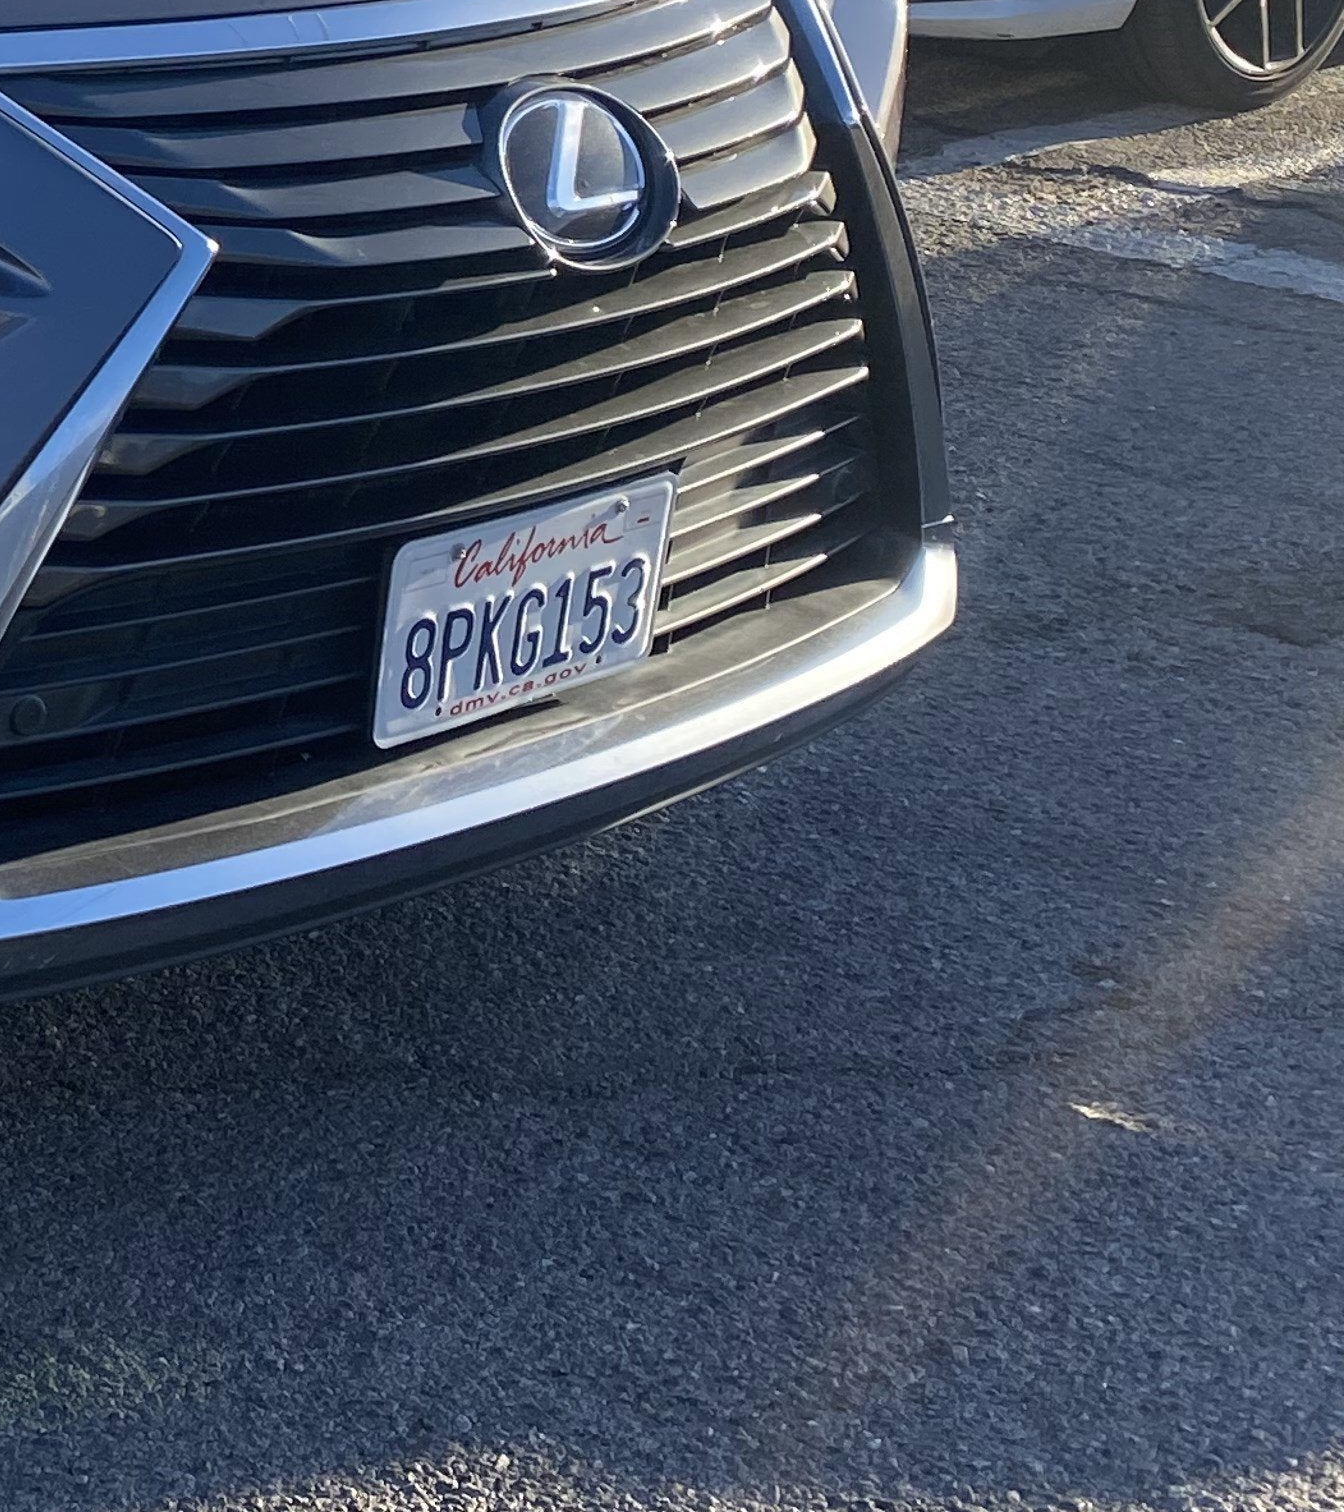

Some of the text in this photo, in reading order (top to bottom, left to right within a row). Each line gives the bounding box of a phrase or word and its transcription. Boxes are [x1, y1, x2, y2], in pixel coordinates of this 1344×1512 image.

[453, 520, 625, 589] California
[400, 556, 648, 710] 8PKG153
[449, 662, 588, 717] dmv.ca.gov
